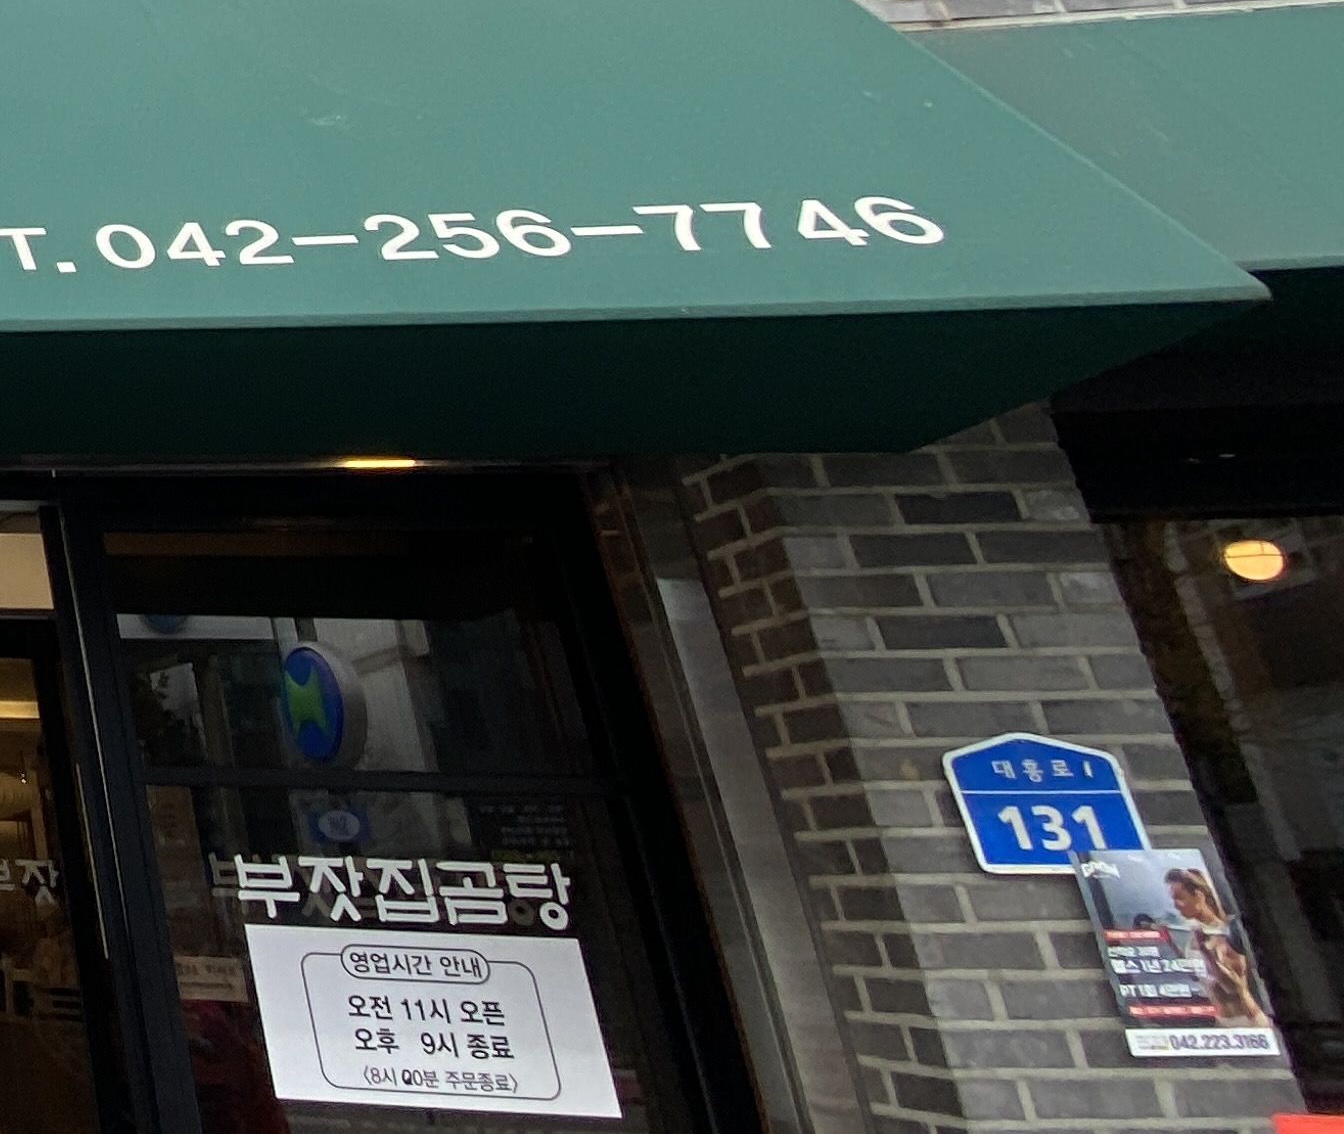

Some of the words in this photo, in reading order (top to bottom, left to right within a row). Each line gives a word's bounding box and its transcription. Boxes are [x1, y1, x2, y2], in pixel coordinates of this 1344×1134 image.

[997, 805, 1109, 851] 131
[234, 854, 570, 930] 부잣집곰탕
[349, 951, 433, 977] 영업시간
[439, 955, 483, 978] 안내
[348, 994, 393, 1020] 오전
[399, 998, 452, 1024] 11시
[460, 1000, 506, 1026] 오픈
[354, 1027, 400, 1054] 오후
[420, 1032, 460, 1058] 9시
[467, 1033, 515, 1060] 종료
